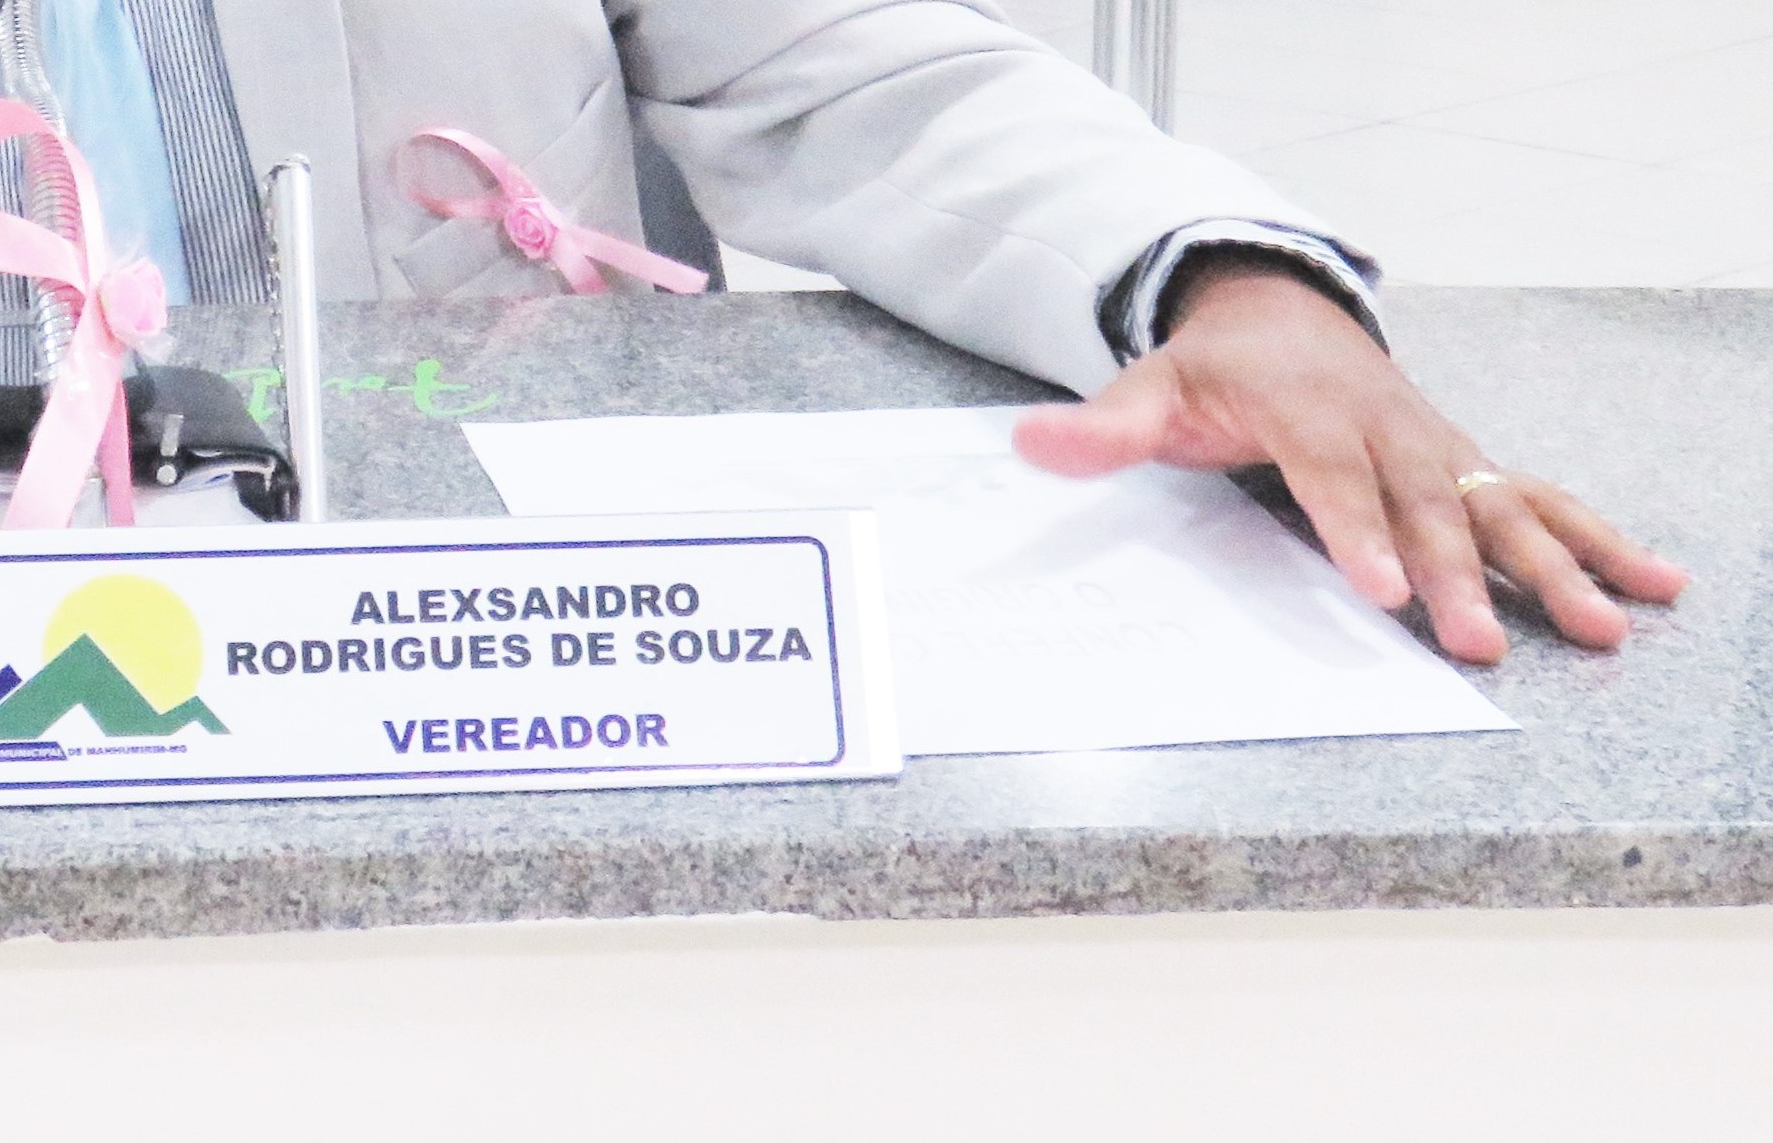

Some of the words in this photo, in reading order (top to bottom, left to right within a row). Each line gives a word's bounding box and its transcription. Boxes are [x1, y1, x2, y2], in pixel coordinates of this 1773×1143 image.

[351, 582, 701, 626] ALEXSANDRO
[226, 633, 532, 676] RODRIGUES
[552, 632, 618, 667] DE
[635, 627, 814, 664] SOUZA
[383, 713, 670, 755] VEREADOR
